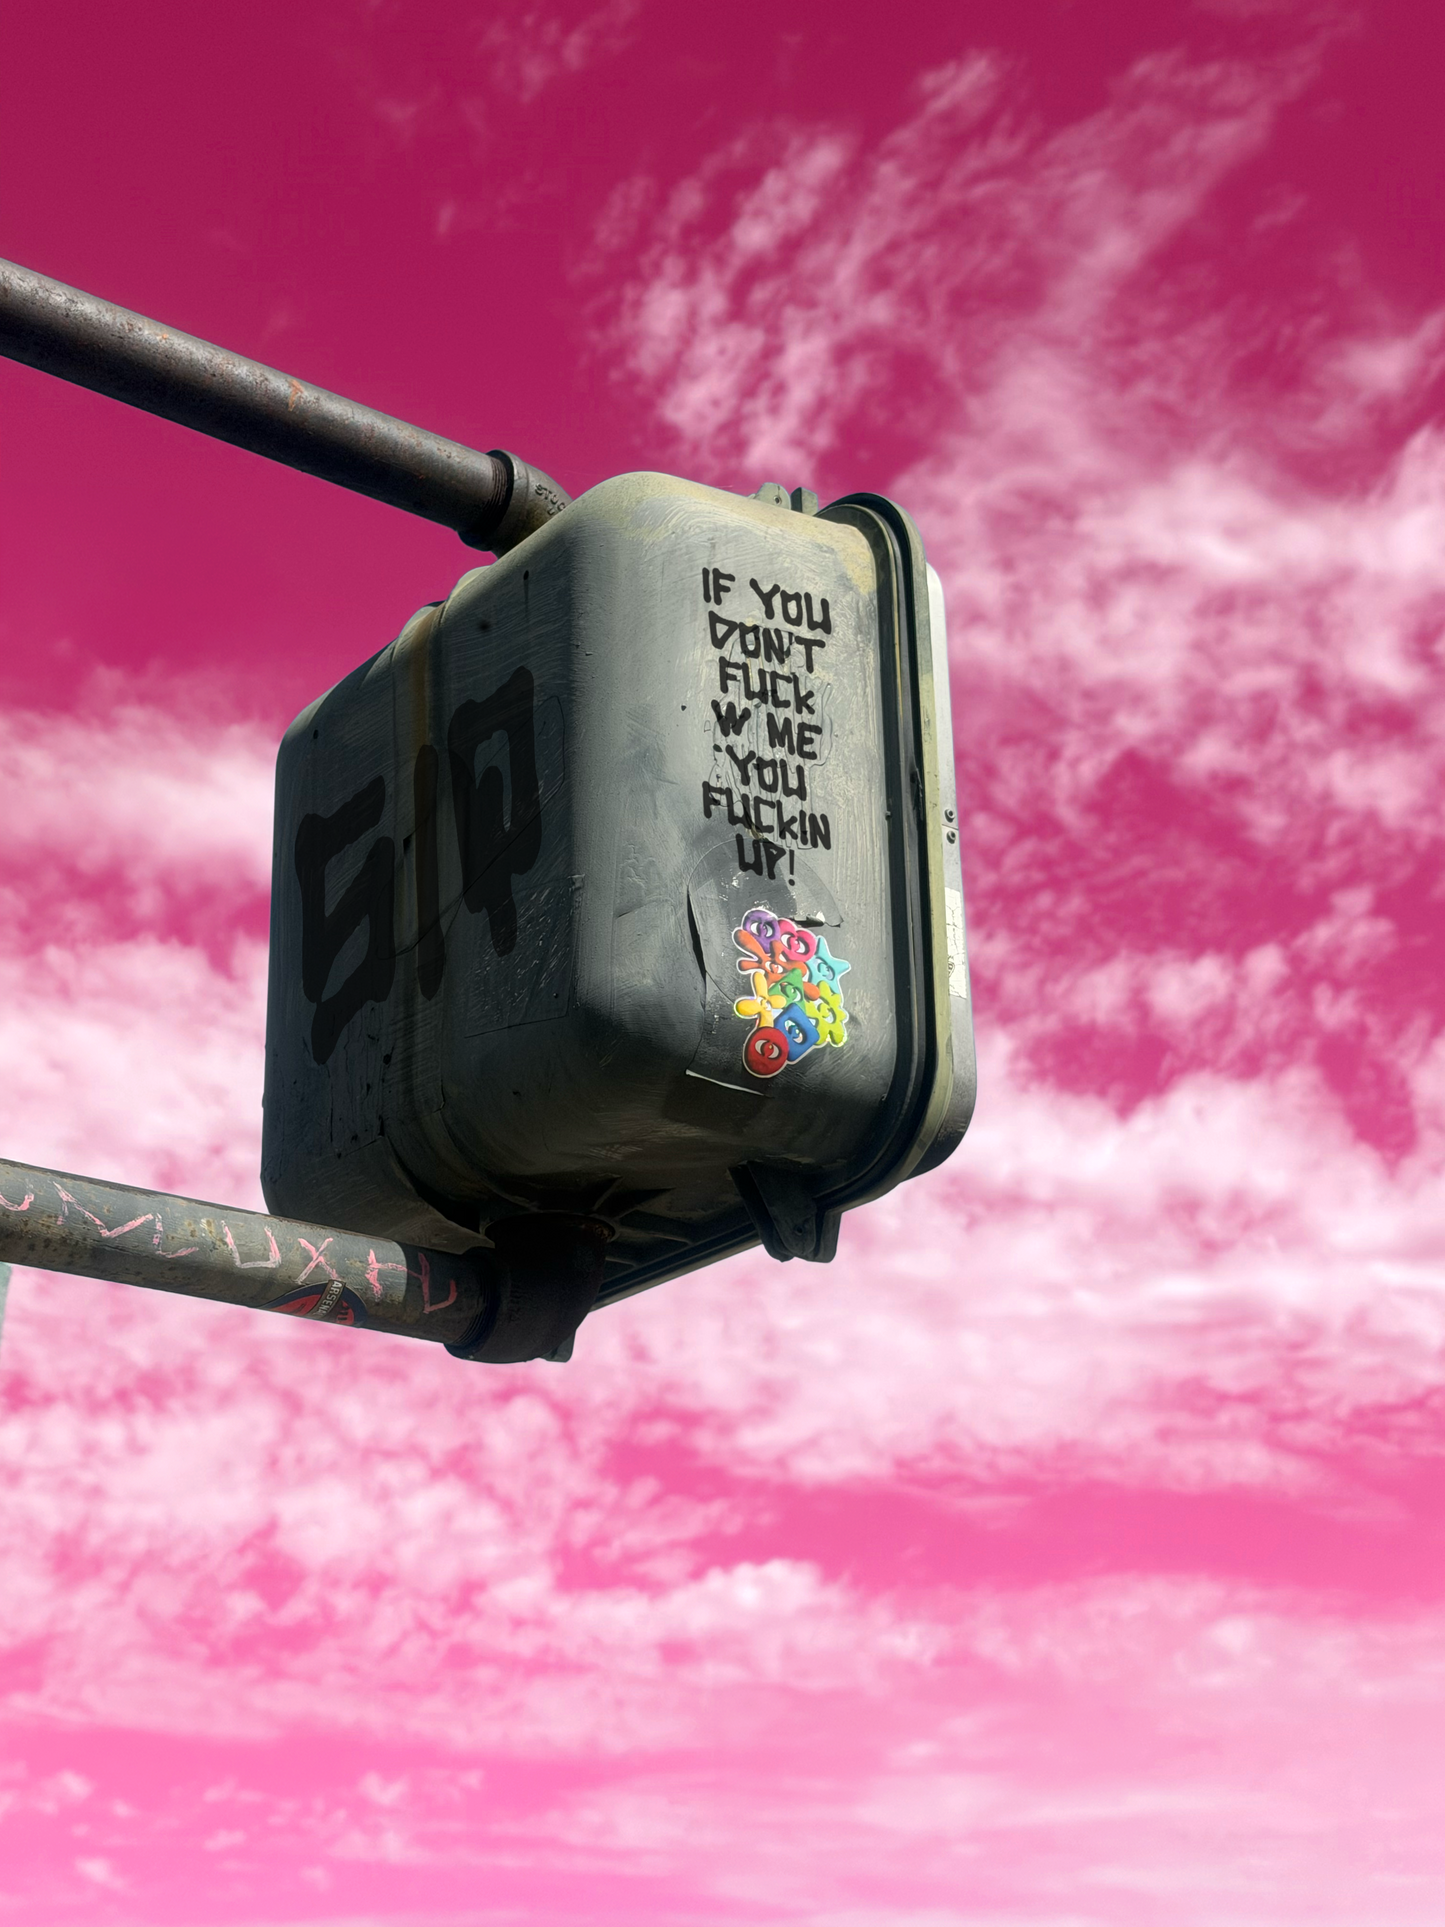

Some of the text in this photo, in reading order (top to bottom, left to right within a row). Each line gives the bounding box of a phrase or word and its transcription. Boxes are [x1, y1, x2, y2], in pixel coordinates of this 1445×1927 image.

[702, 567, 832, 635] IF YOU
[708, 610, 826, 674] DON'T
[711, 699, 823, 760] W ME
[725, 744, 807, 802] YOU
[735, 833, 796, 887] UP!
